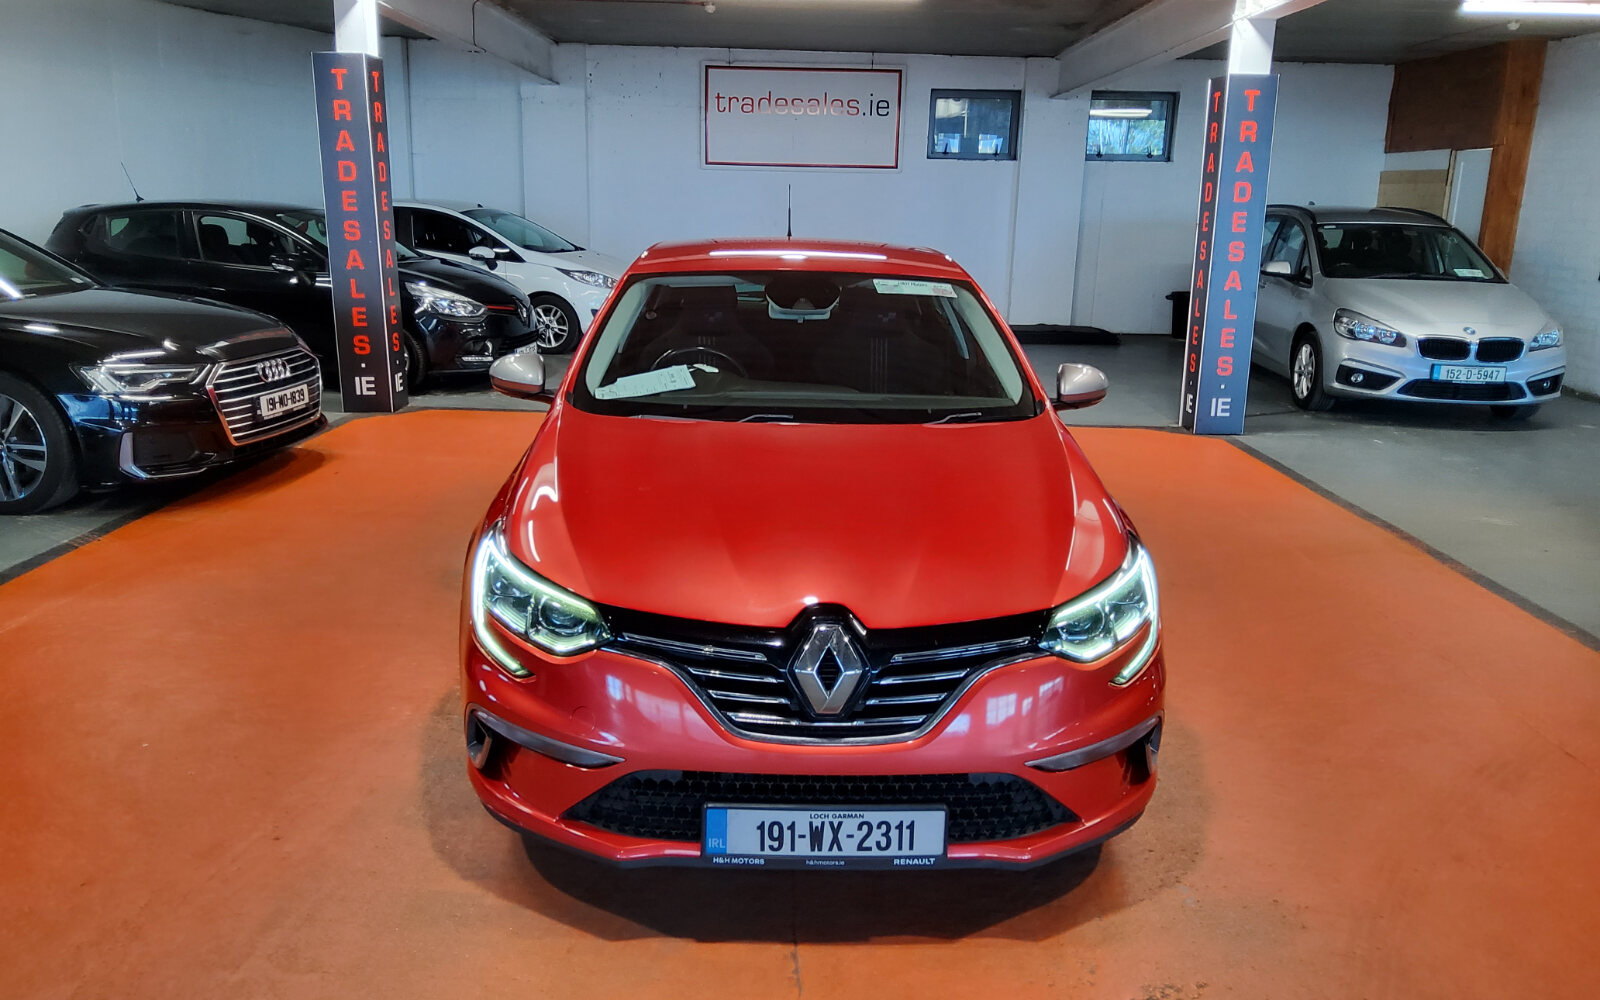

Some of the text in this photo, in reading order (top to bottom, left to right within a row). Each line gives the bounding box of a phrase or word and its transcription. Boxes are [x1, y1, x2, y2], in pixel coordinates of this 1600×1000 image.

[715, 90, 890, 117] tradesales.ie
[1446, 368, 1500, 380] 152-D-5947
[756, 820, 915, 852] 191-WX-2311
[708, 838, 726, 849] IRL
[893, 857, 936, 866] RENAULT
